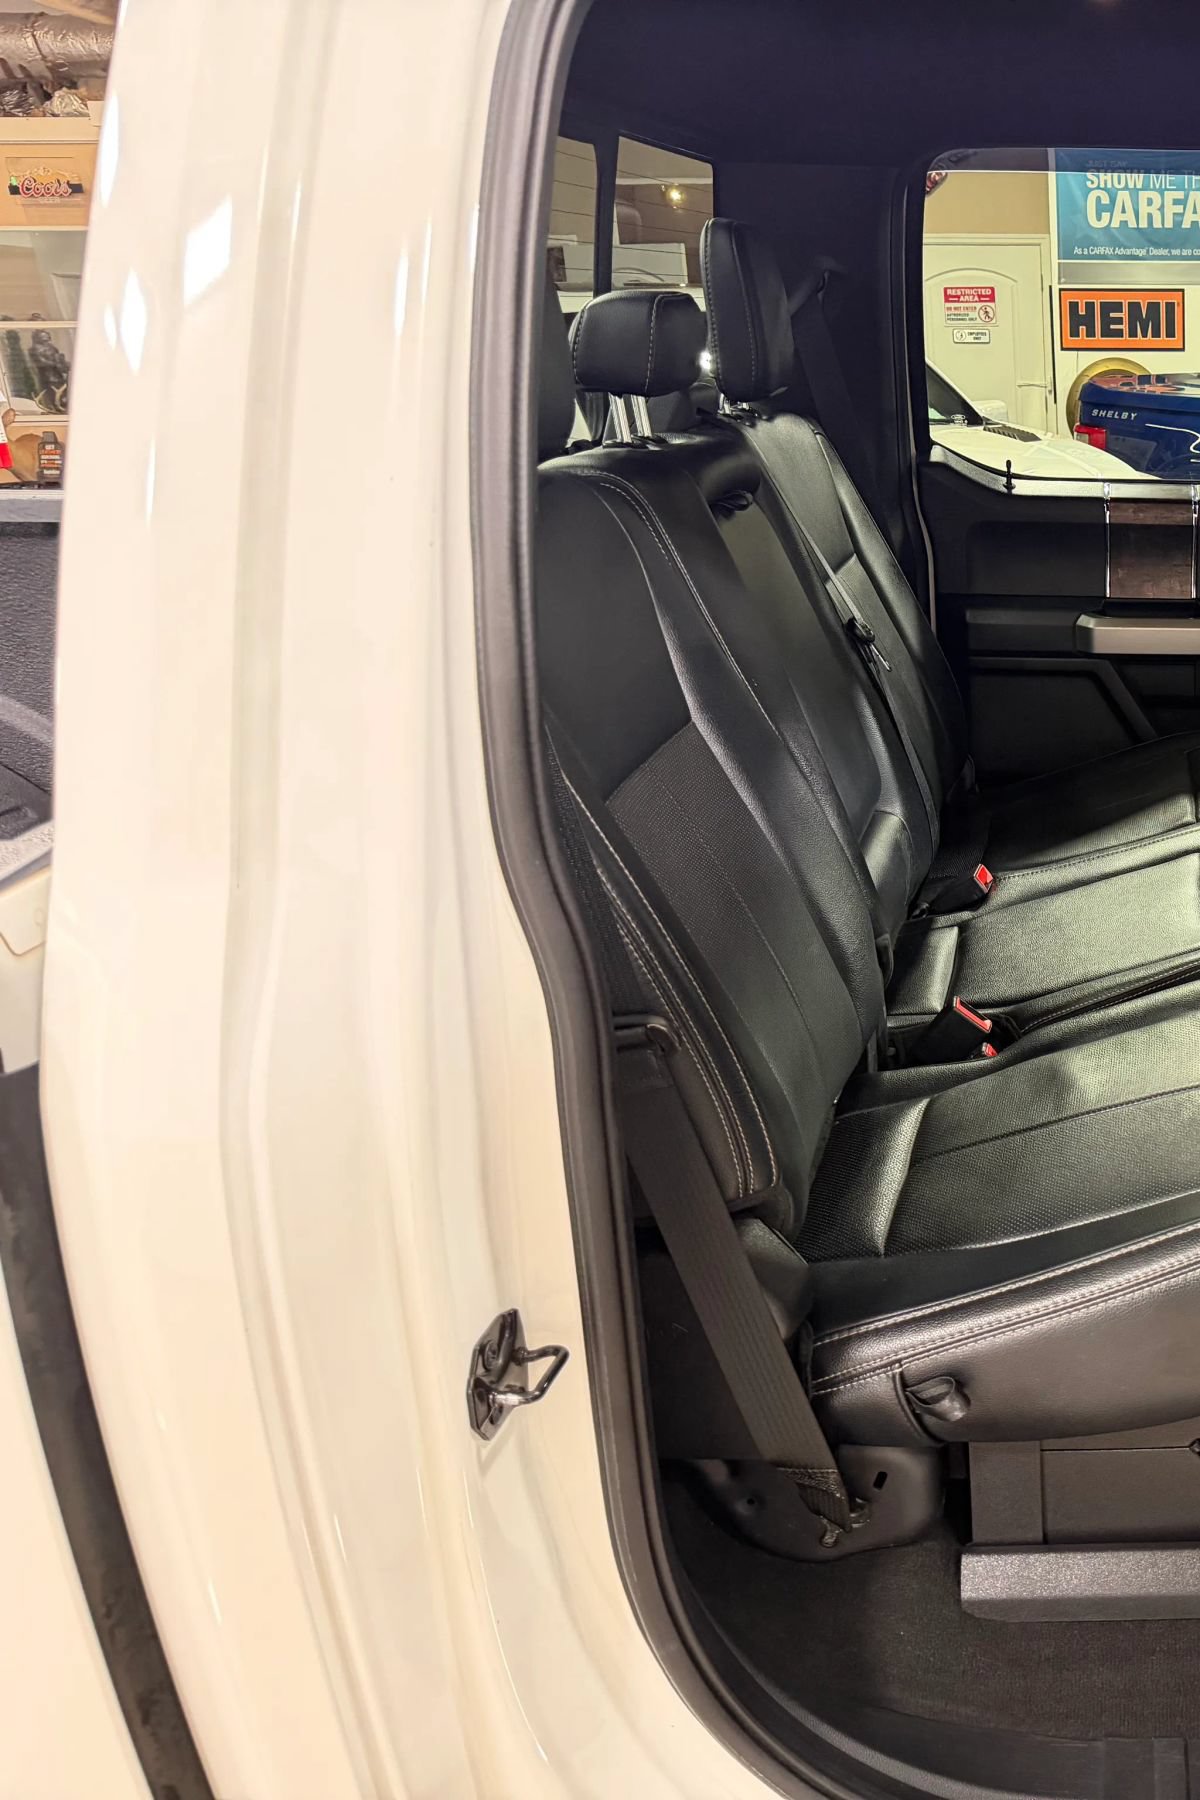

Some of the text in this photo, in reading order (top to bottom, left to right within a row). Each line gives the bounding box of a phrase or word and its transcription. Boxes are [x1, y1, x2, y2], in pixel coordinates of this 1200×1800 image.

[19, 176, 72, 198] Coors
[1086, 169, 1144, 189] SHOW
[1150, 169, 1177, 189] ME
[1089, 246, 1114, 254] CARFAX
[1150, 247, 1170, 256] Dealer,
[1067, 300, 1177, 340] HEMI
[1091, 408, 1138, 420] SHELBY
